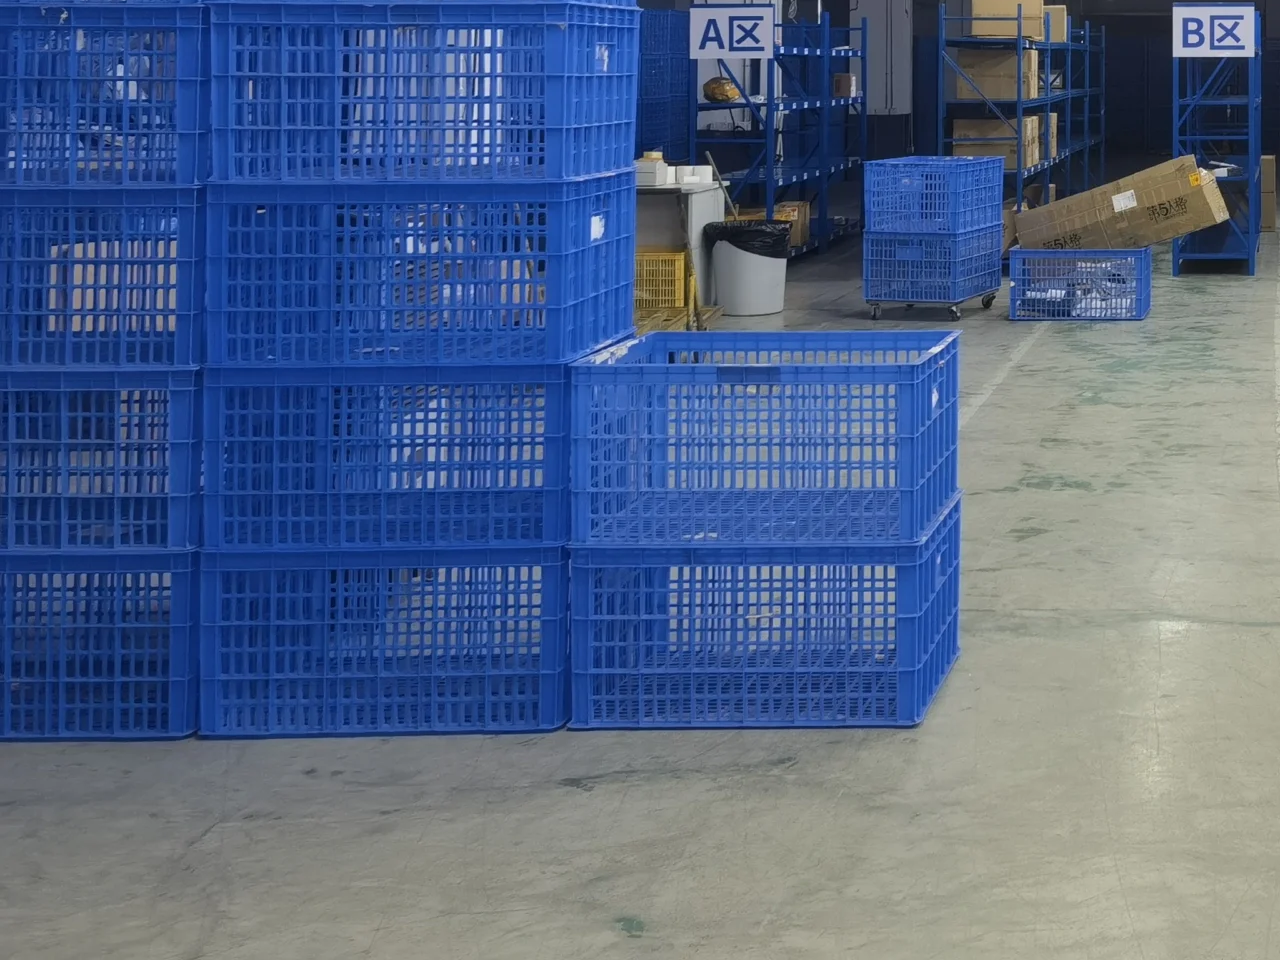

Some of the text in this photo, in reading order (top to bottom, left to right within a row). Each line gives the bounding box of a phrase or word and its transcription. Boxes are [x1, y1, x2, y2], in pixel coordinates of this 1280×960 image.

[698, 15, 765, 52] A区
[1181, 14, 1246, 51] B区
[1146, 196, 1188, 223] 第5人格
